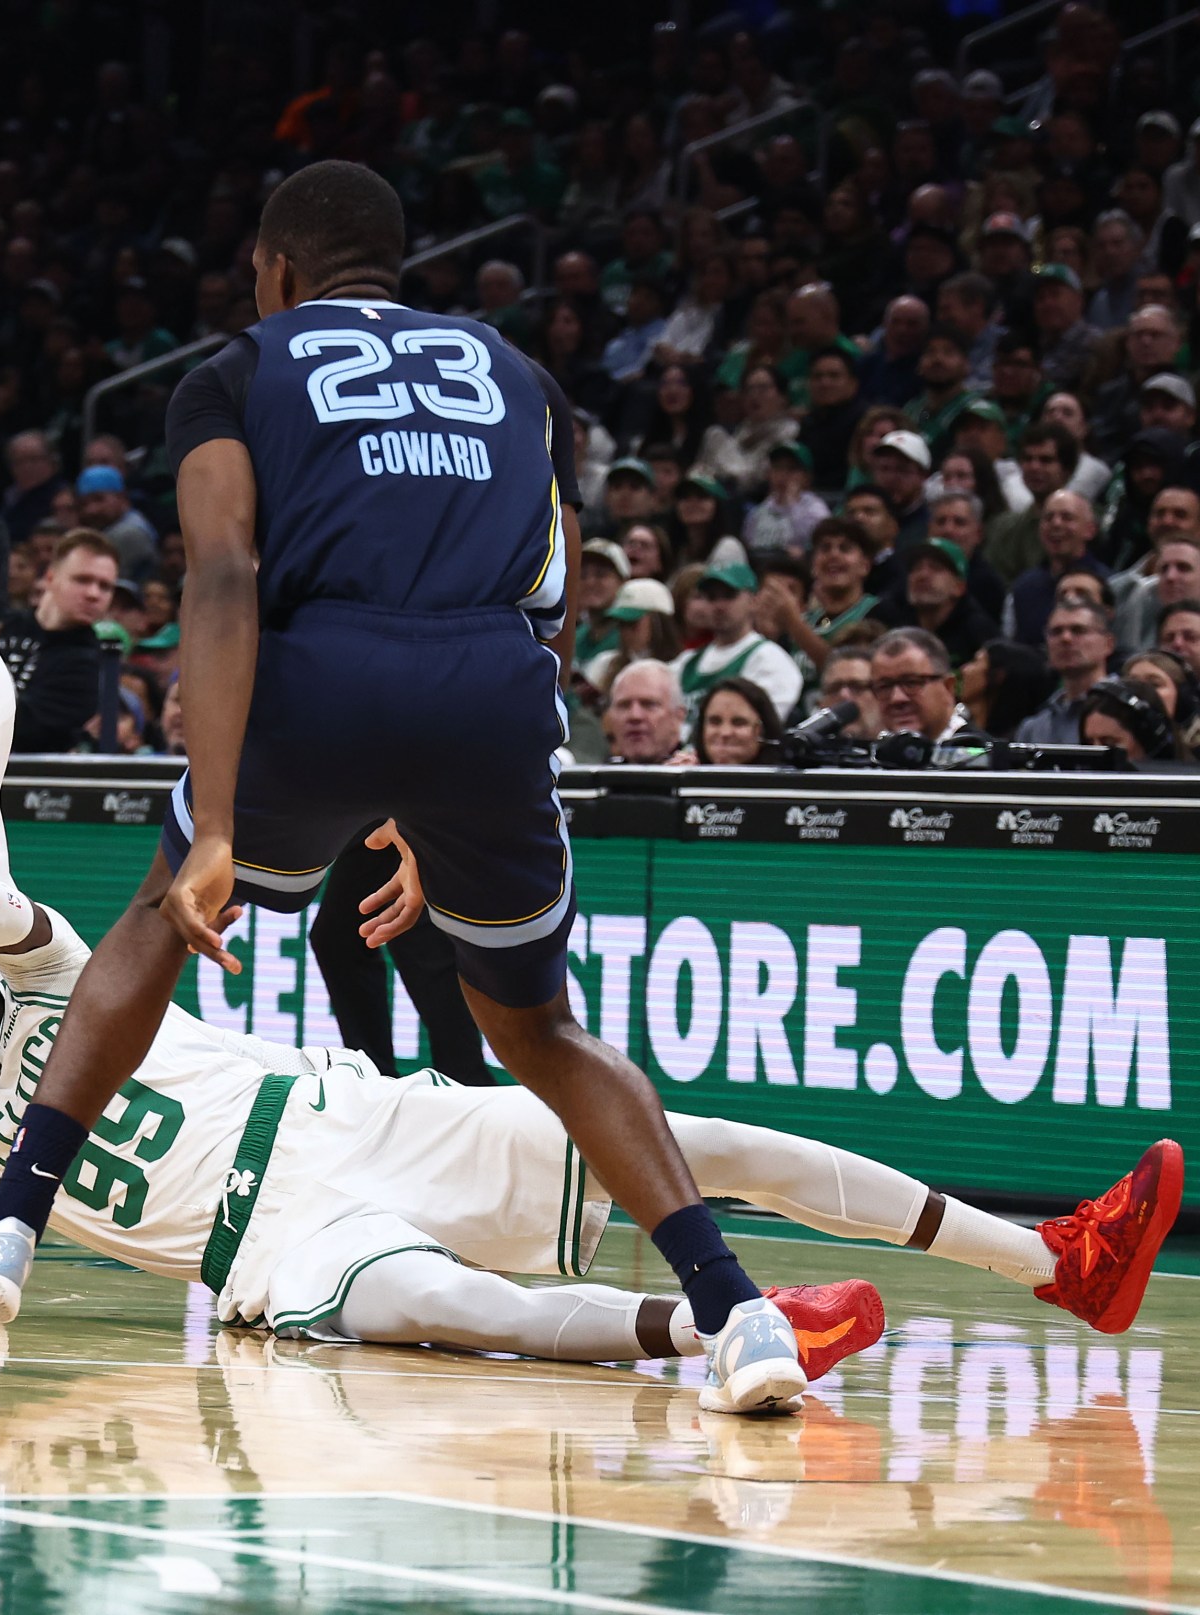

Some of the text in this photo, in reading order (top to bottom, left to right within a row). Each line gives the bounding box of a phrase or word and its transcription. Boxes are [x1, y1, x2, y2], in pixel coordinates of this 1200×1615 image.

[289, 328, 506, 425] 23
[359, 430, 492, 481] COWARD
[699, 825, 738, 837] BOSTON
[800, 828, 840, 839] BOSTON
[903, 830, 945, 842] BOSTON
[1011, 832, 1054, 844] BOSTON
[1108, 835, 1152, 847] BOSTON
[197, 902, 1172, 1110] CELTORE.COM
[2, 1003, 24, 1048] Amica
[62, 1077, 186, 1229] 99
